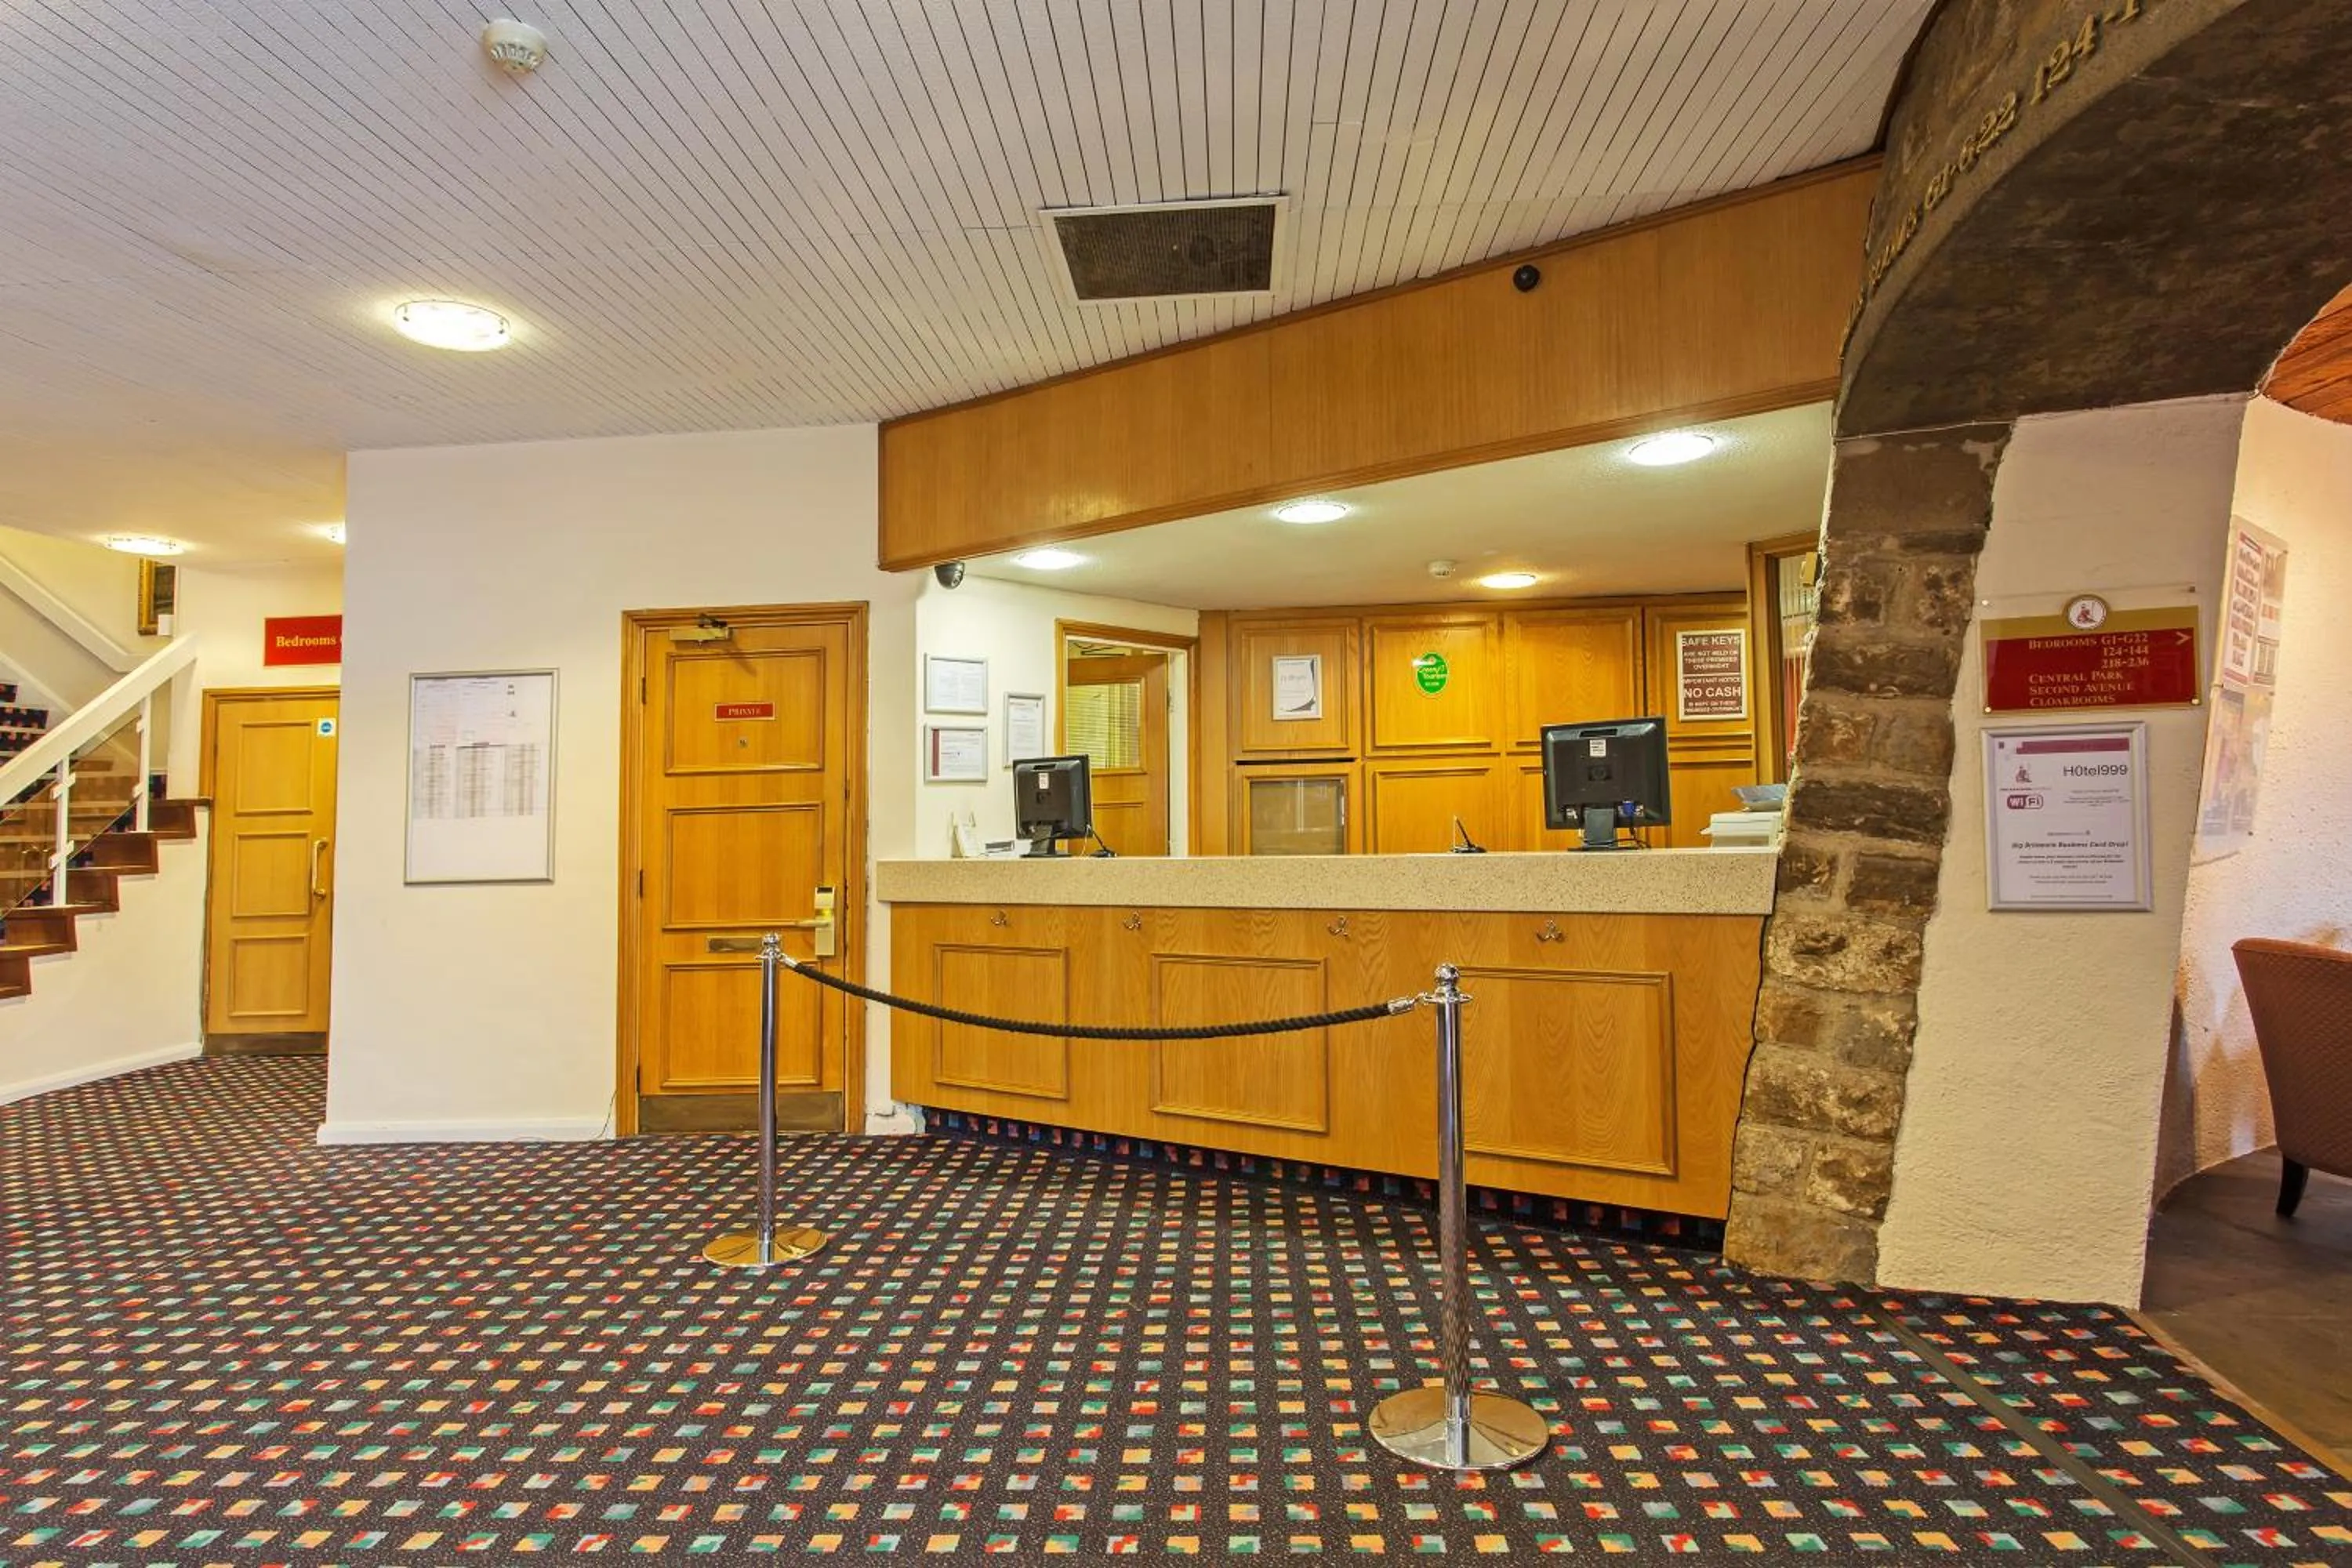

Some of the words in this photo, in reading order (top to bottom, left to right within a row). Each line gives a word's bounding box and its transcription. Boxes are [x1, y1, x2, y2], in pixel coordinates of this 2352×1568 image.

[276, 635, 336, 647] Bedrooms
[1682, 637, 1708, 647] SAFE
[2092, 670, 2124, 681] PARK
[1684, 688, 1702, 699] NO
[1705, 686, 1741, 697] CASH
[2029, 684, 2080, 695] SECOND
[2085, 681, 2134, 693] AVENUE
[2029, 695, 2116, 707] CLOAKROOMS
